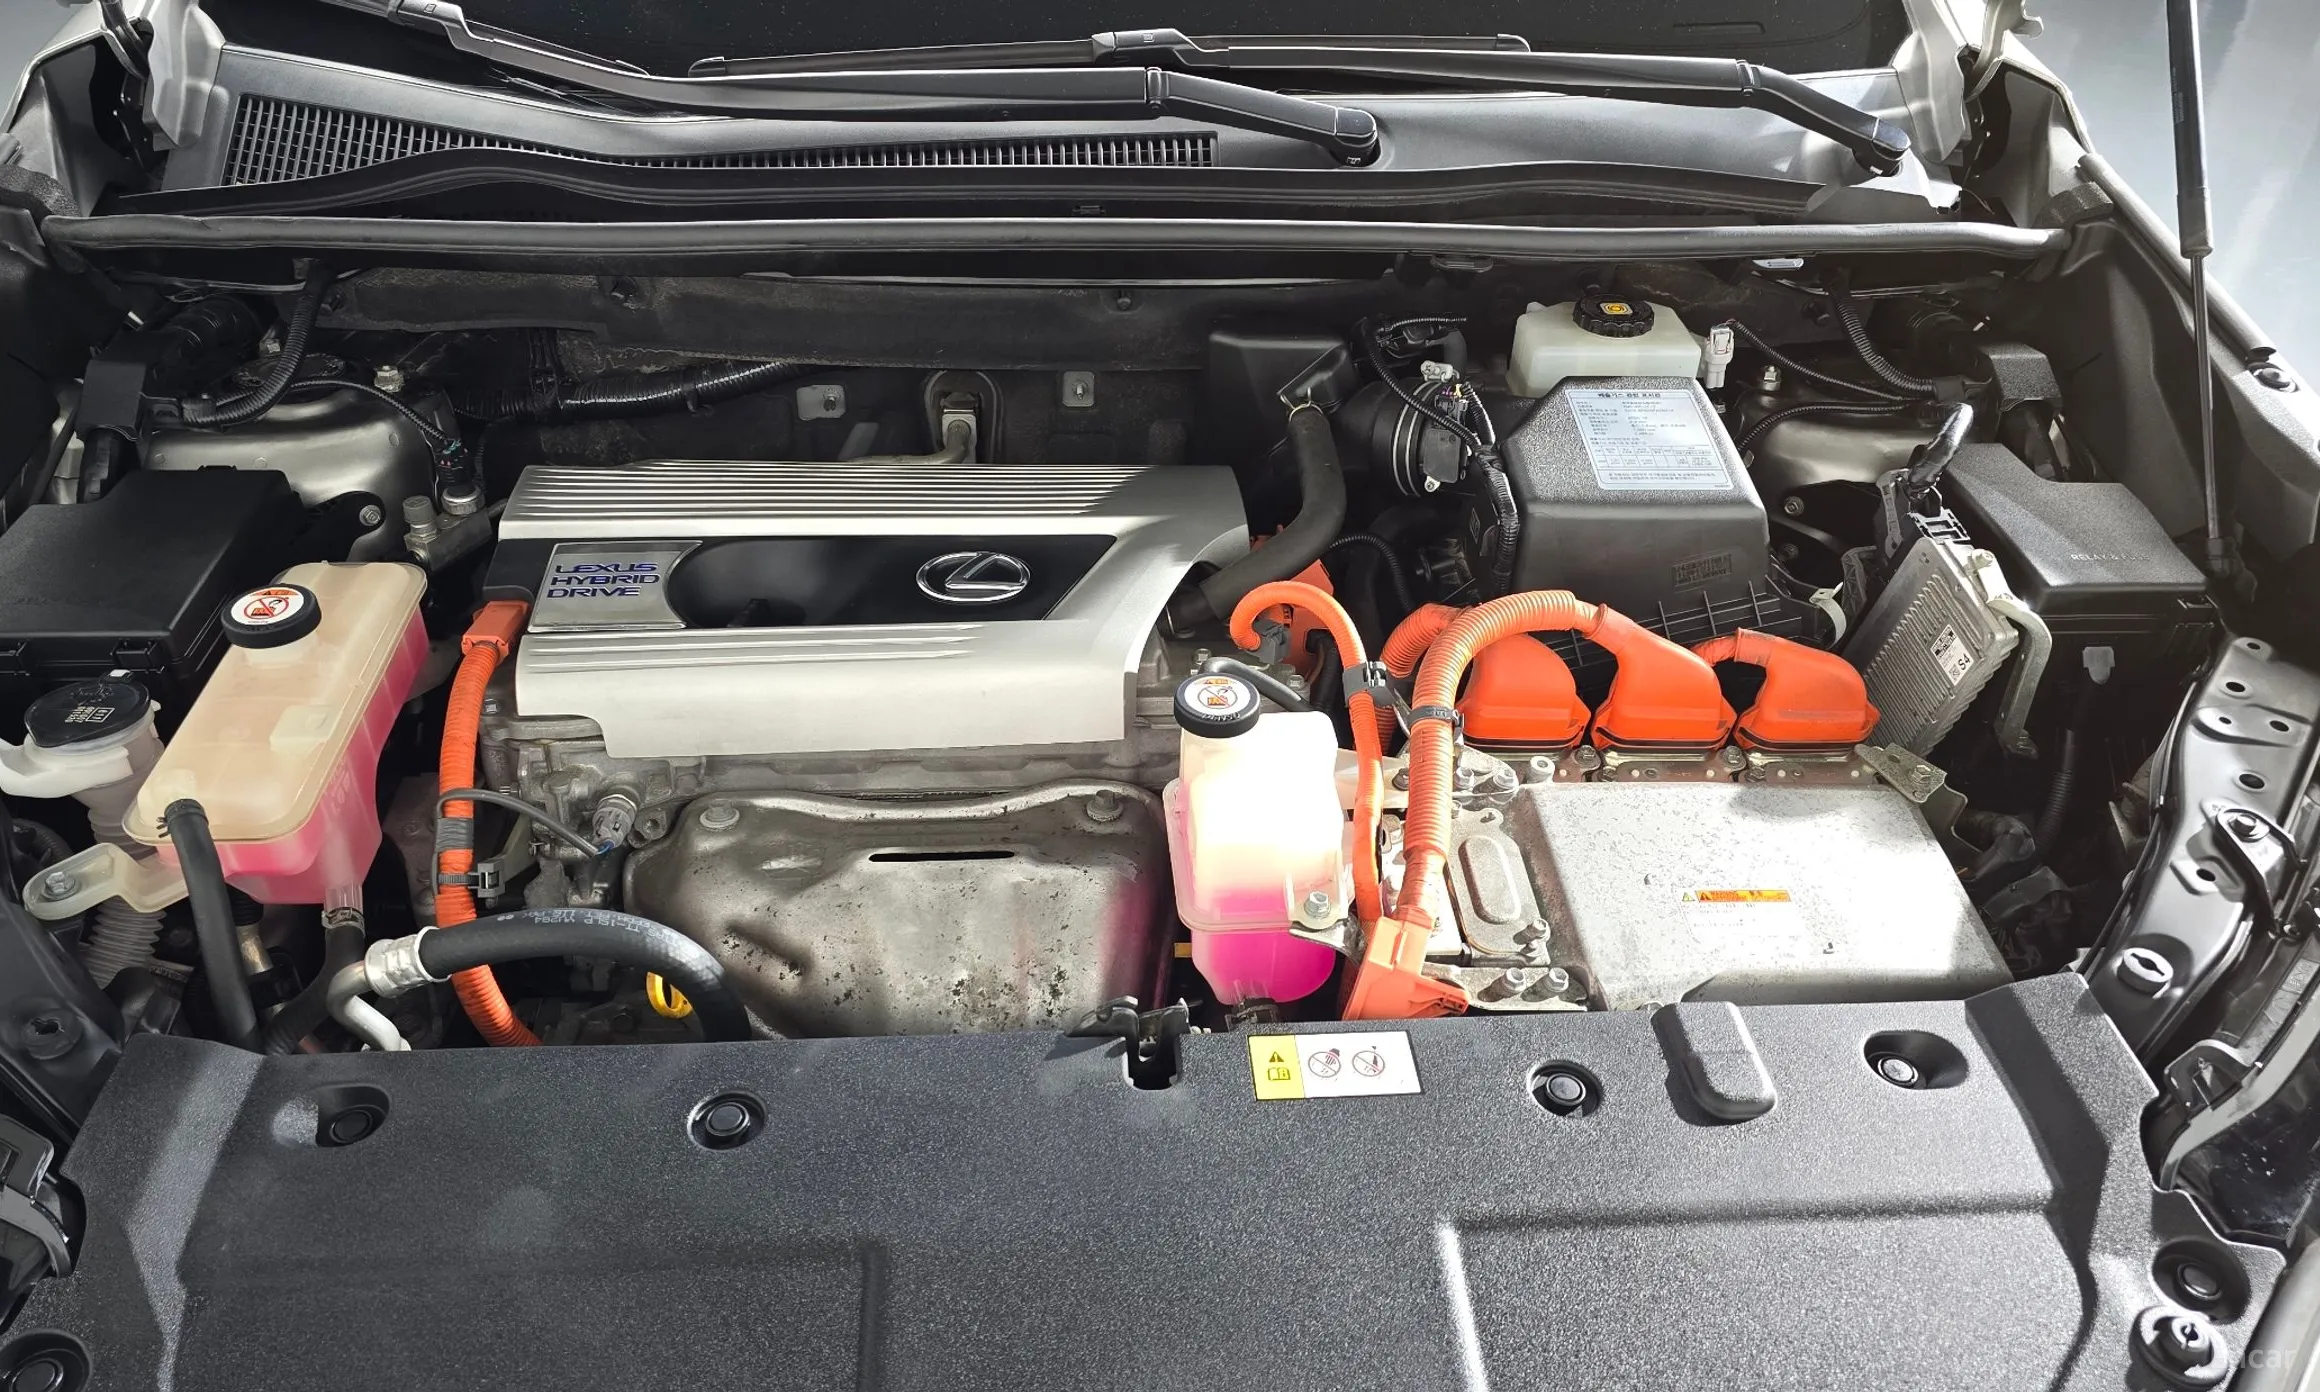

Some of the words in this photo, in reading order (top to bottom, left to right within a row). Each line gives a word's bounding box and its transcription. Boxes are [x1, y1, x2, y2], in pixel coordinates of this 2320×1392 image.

[2070, 553, 2106, 561] RELAY
[555, 563, 658, 574] LEXUS
[550, 574, 660, 586] HYBRID
[547, 586, 641, 599] DRIVE
[1957, 653, 1971, 671] S4
